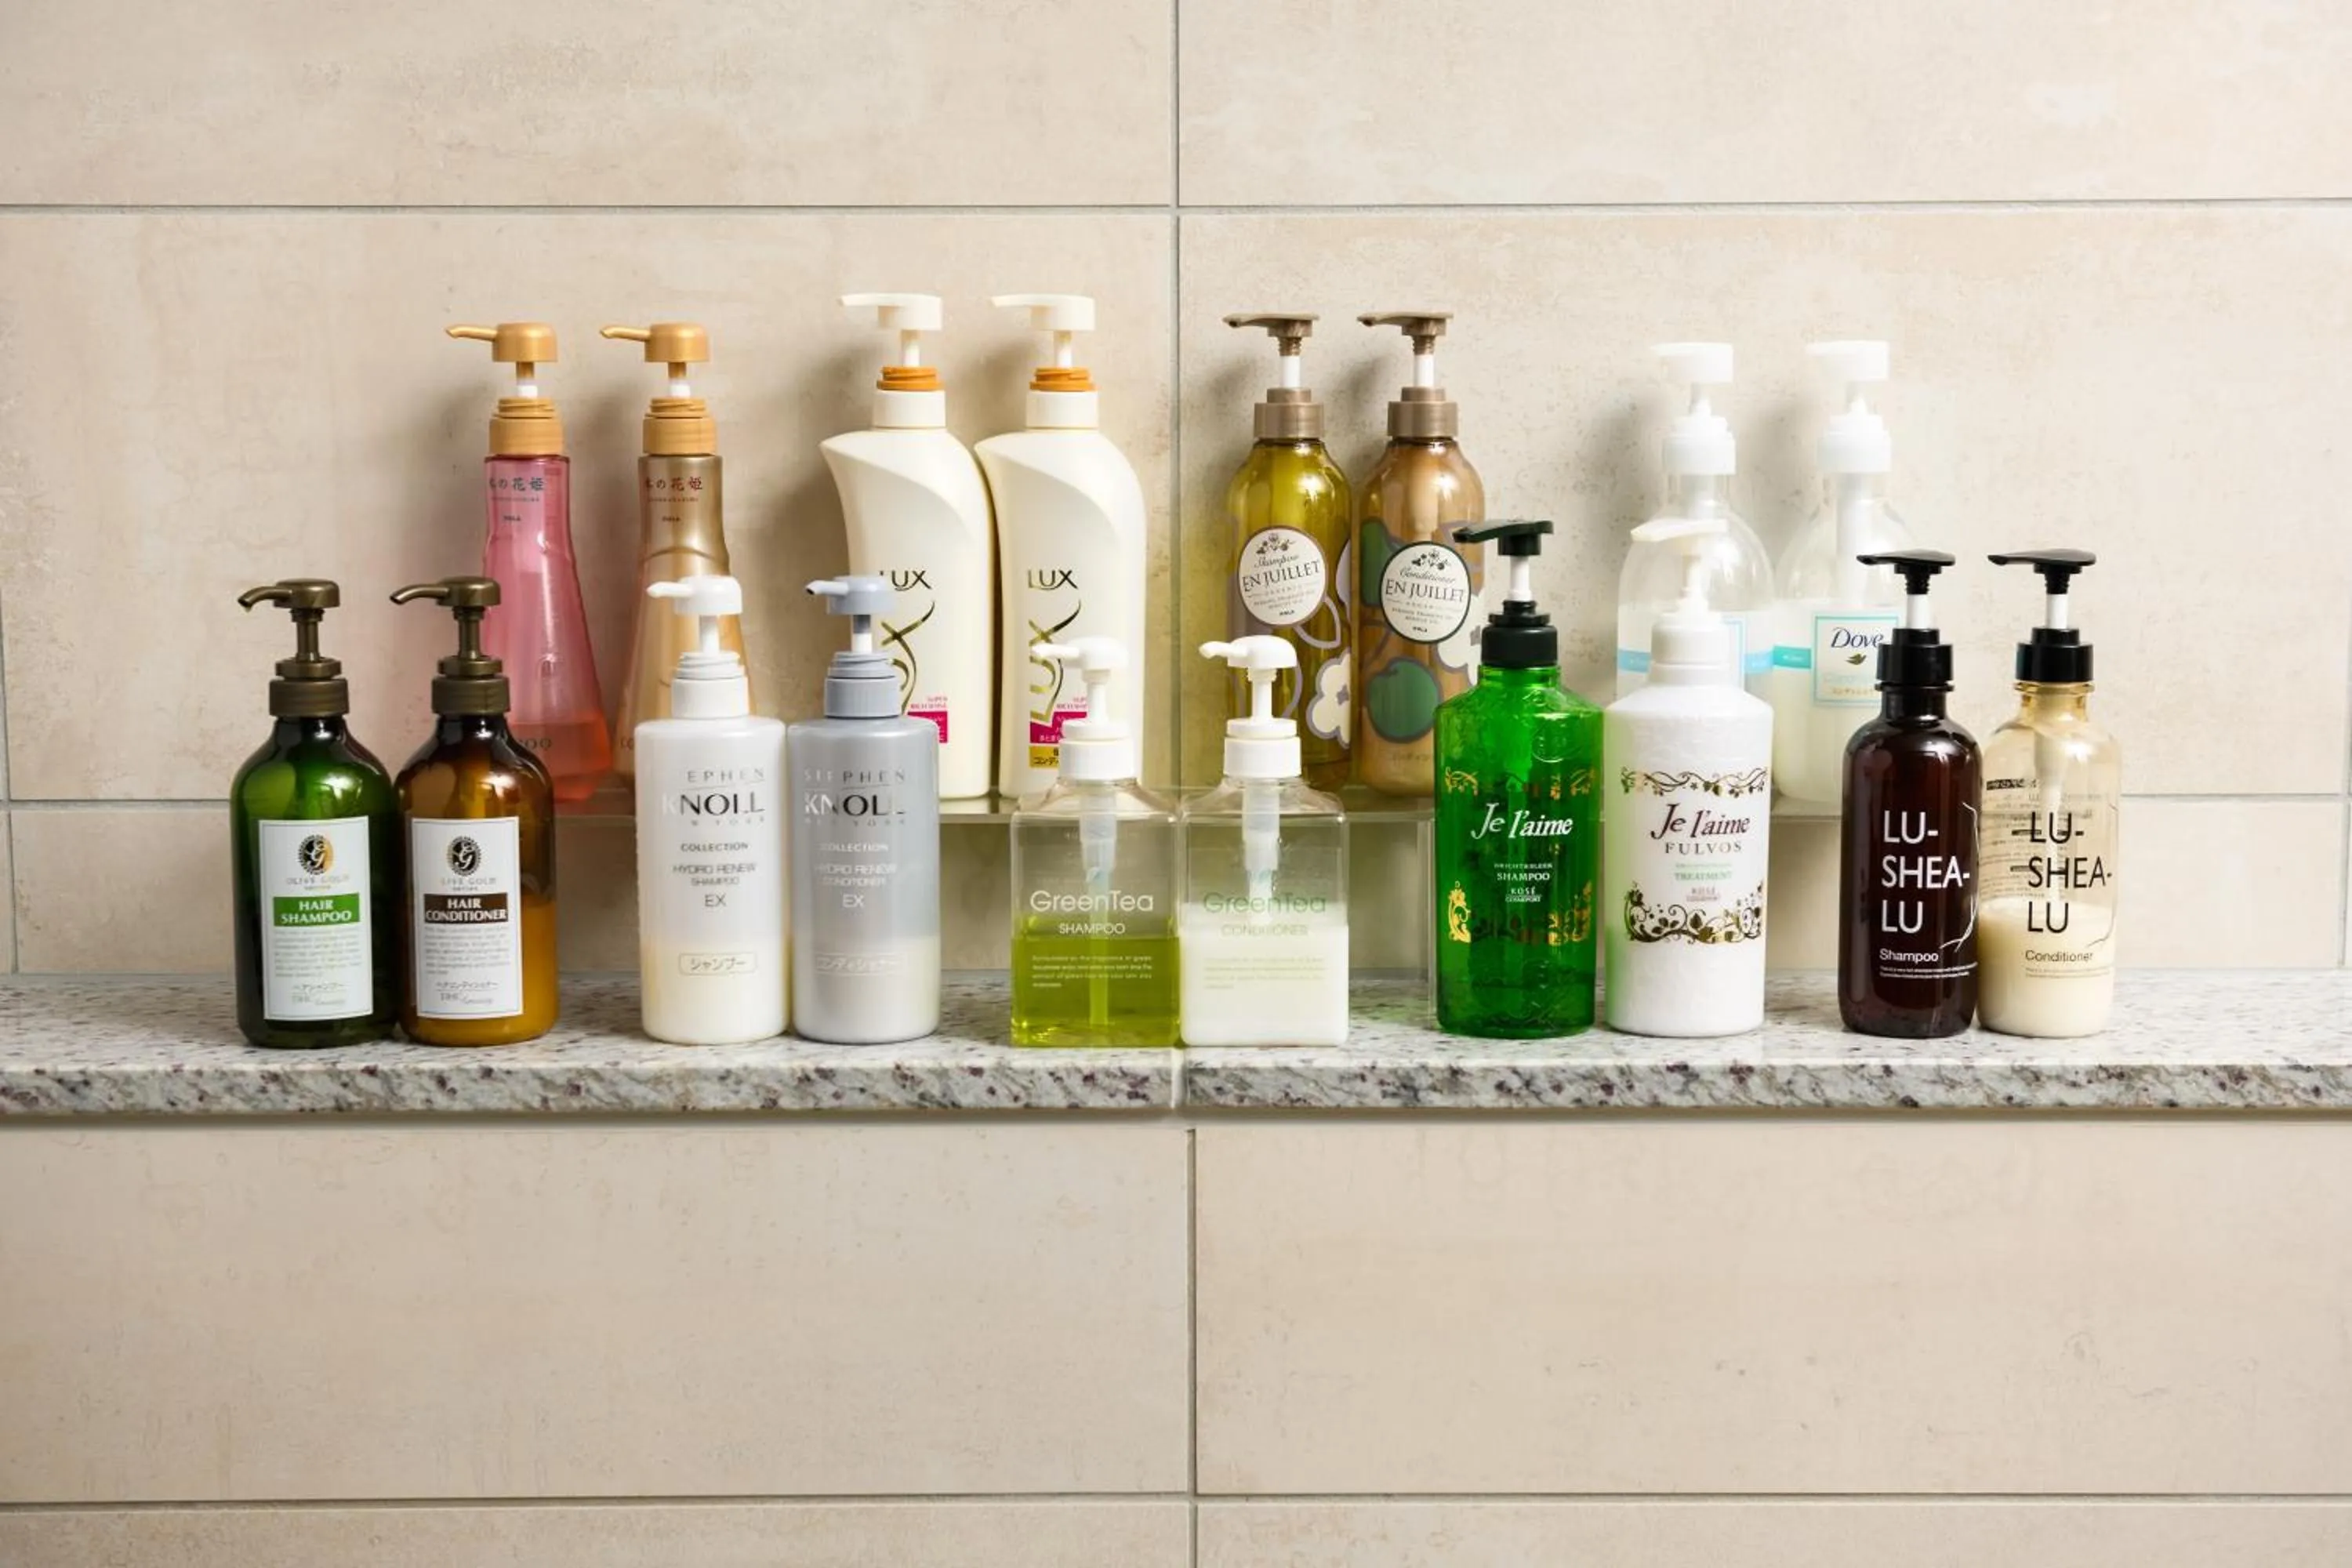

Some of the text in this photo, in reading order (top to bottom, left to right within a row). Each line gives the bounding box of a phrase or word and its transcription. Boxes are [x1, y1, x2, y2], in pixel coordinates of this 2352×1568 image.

[880, 570, 933, 590] UX
[1028, 570, 1078, 590] LUX
[1243, 560, 1320, 592] EN JUILLET
[1385, 578, 1464, 602] EN JUILLET
[1830, 626, 1884, 648] Dove
[662, 791, 766, 816] KNOLL
[1471, 802, 1573, 839] Je l'aime
[1650, 803, 1750, 839] Je l'aime
[1884, 810, 1939, 844] LU-
[2030, 811, 2085, 844] LU-
[680, 841, 750, 852] COLLECTION
[1664, 840, 1742, 855] FULVOS
[1497, 872, 1550, 881] SHAMPOO
[1882, 855, 1970, 888] SHEA-
[2028, 855, 2113, 888] SHEA-
[299, 899, 334, 911] HAIR
[447, 898, 482, 909] HAIR
[705, 893, 727, 907] EX
[843, 894, 865, 908] EX
[1029, 890, 1153, 912] GreenTea
[281, 910, 353, 924] SHAMPOO
[426, 909, 508, 922] CONDITIONER
[1882, 899, 1924, 934] LU
[2027, 901, 2069, 933] LU
[1058, 923, 1126, 935] SHAMPOO
[1879, 948, 1939, 964] Shampoo
[2025, 949, 2094, 962] Conditioner
